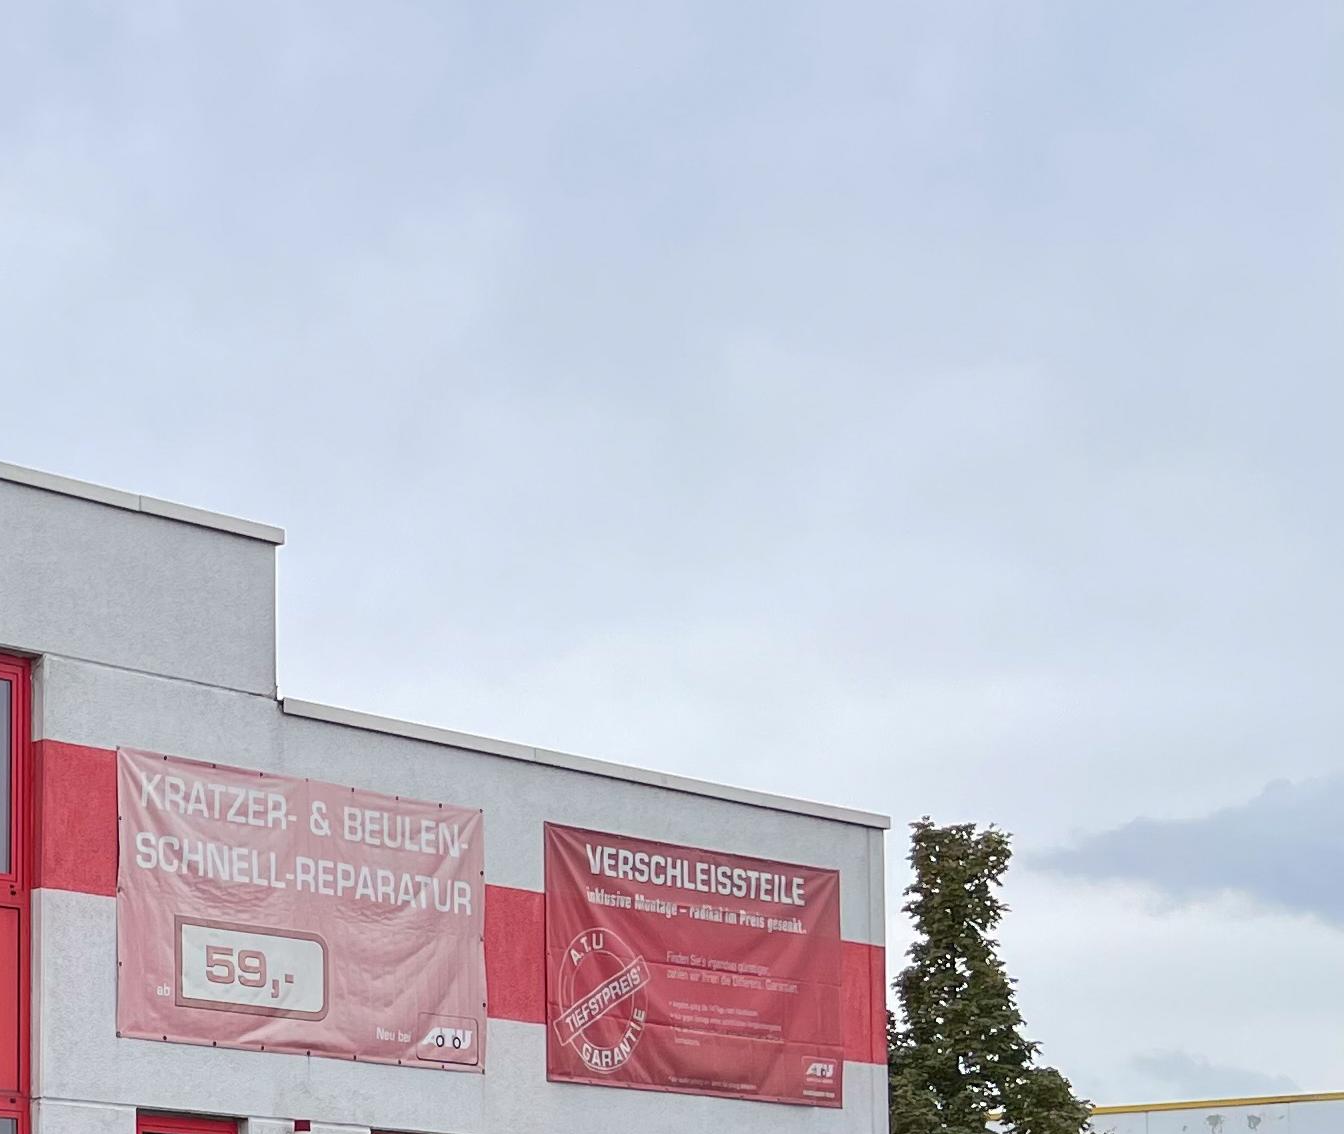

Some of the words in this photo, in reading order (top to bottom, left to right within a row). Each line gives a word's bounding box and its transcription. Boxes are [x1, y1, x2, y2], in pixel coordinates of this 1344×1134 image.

[140, 770, 297, 830] KRATZER-
[310, 801, 332, 837] &
[343, 807, 469, 858] BEULEN-
[135, 831, 472, 915] SCHNELL-REPARATUR
[585, 843, 806, 906] VERSCHLEISSTEILE
[586, 886, 632, 909] inklusive
[634, 894, 678, 919] Montage
[689, 904, 723, 924] radikal
[725, 908, 737, 925] im
[739, 910, 765, 929] Preis
[767, 916, 807, 935] gesenkt.
[156, 983, 171, 997] ab
[205, 945, 295, 999] 59,-
[376, 1027, 395, 1042] Neu
[397, 1028, 412, 1043] bei
[581, 1008, 646, 1067] GARANTIE
